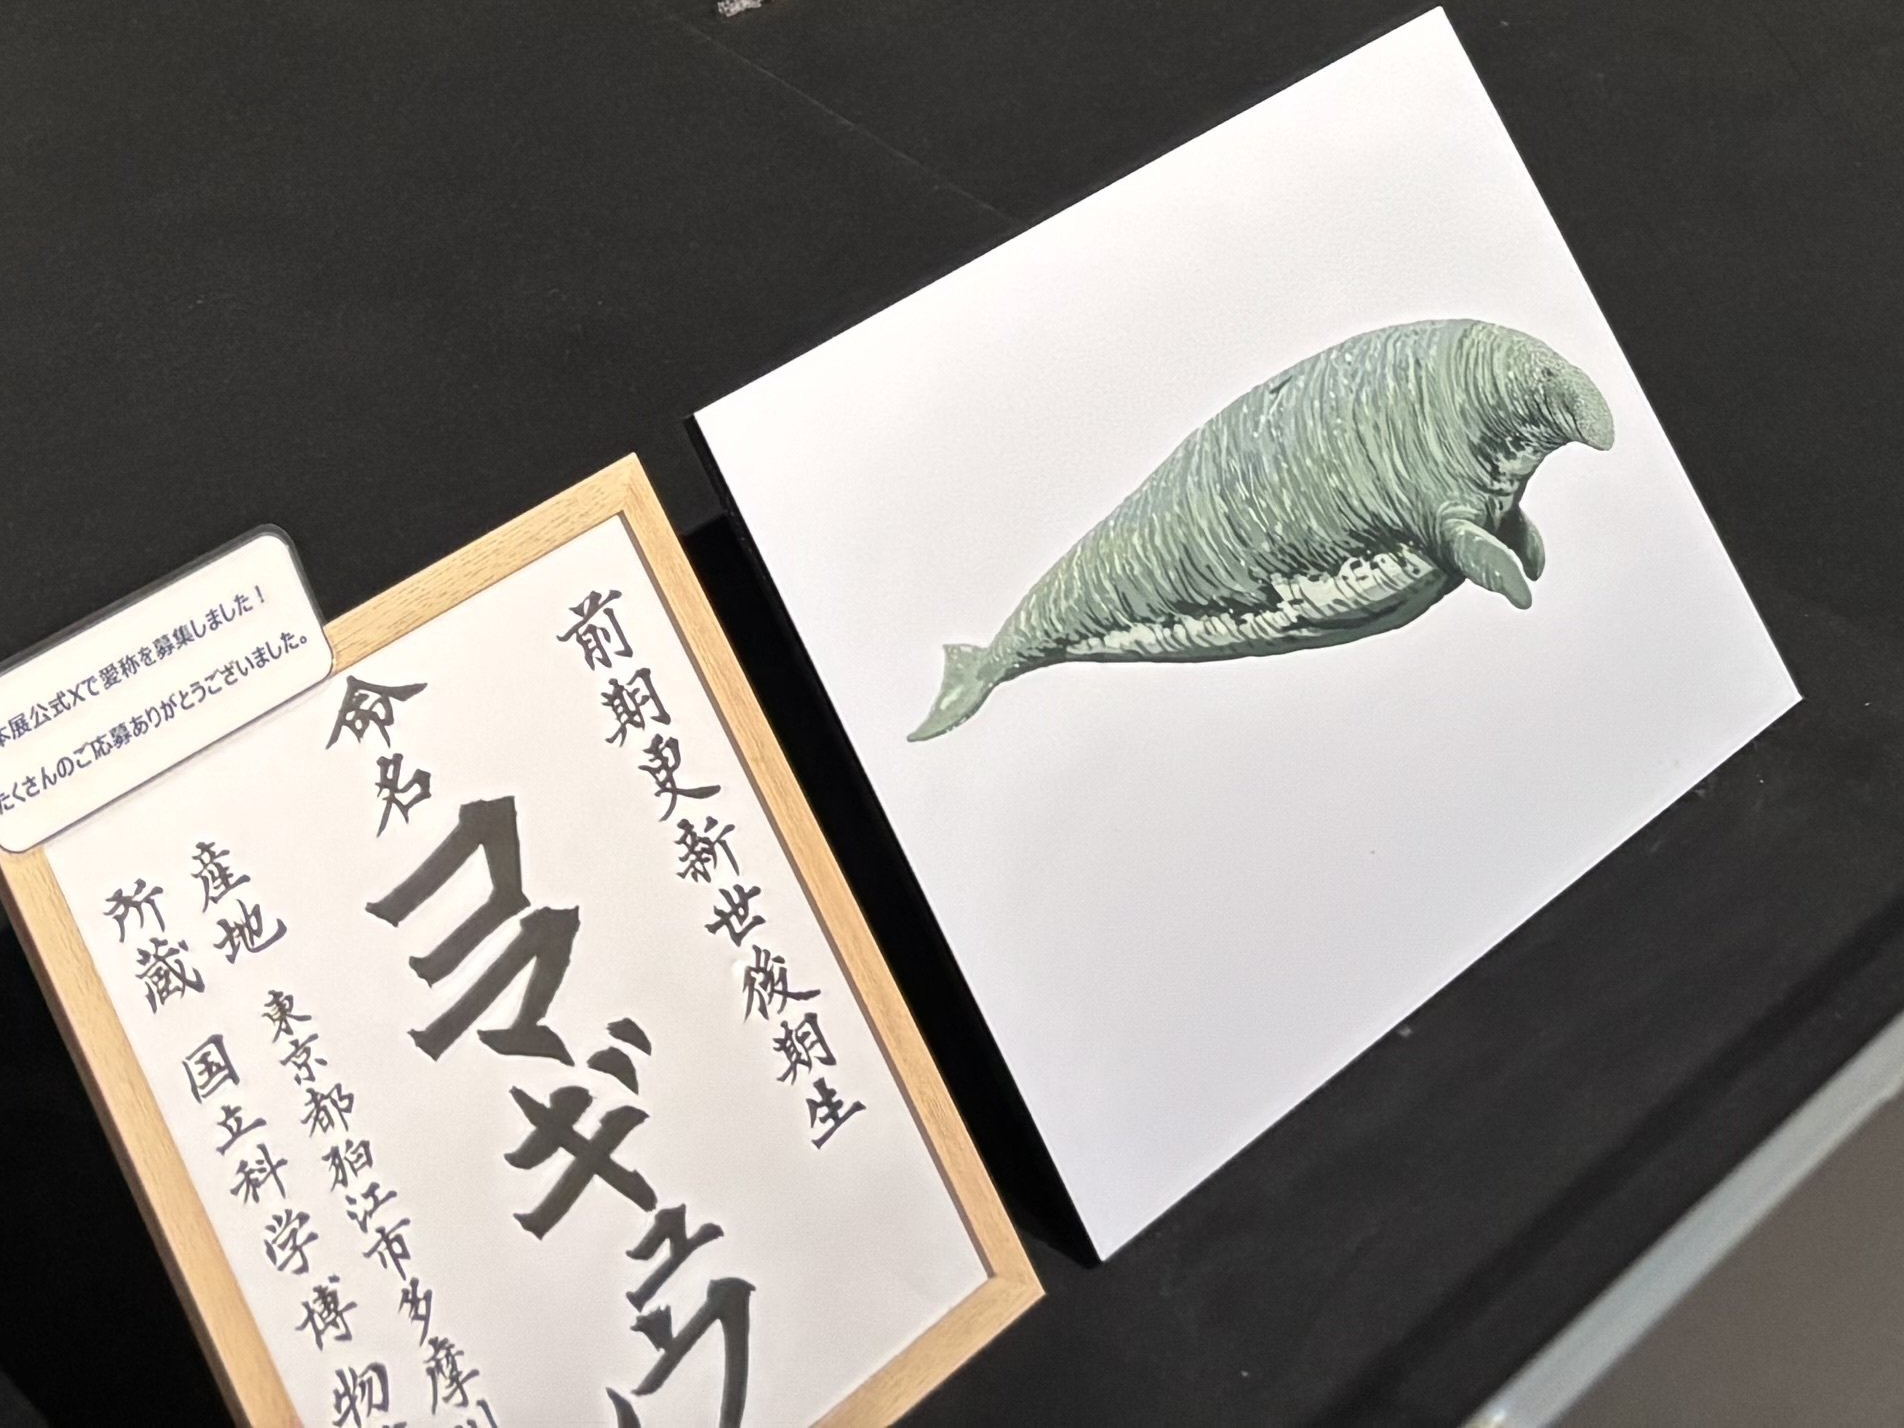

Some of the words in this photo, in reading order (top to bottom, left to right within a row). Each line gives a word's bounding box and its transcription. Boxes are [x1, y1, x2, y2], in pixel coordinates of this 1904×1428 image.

[192, 842, 287, 964] 産地
[326, 675, 432, 837] 命名
[556, 589, 867, 1150] 前期更新世後期生
[104, 878, 205, 1014] 所蔵
[182, 1034, 407, 1428] 国立科学博物
